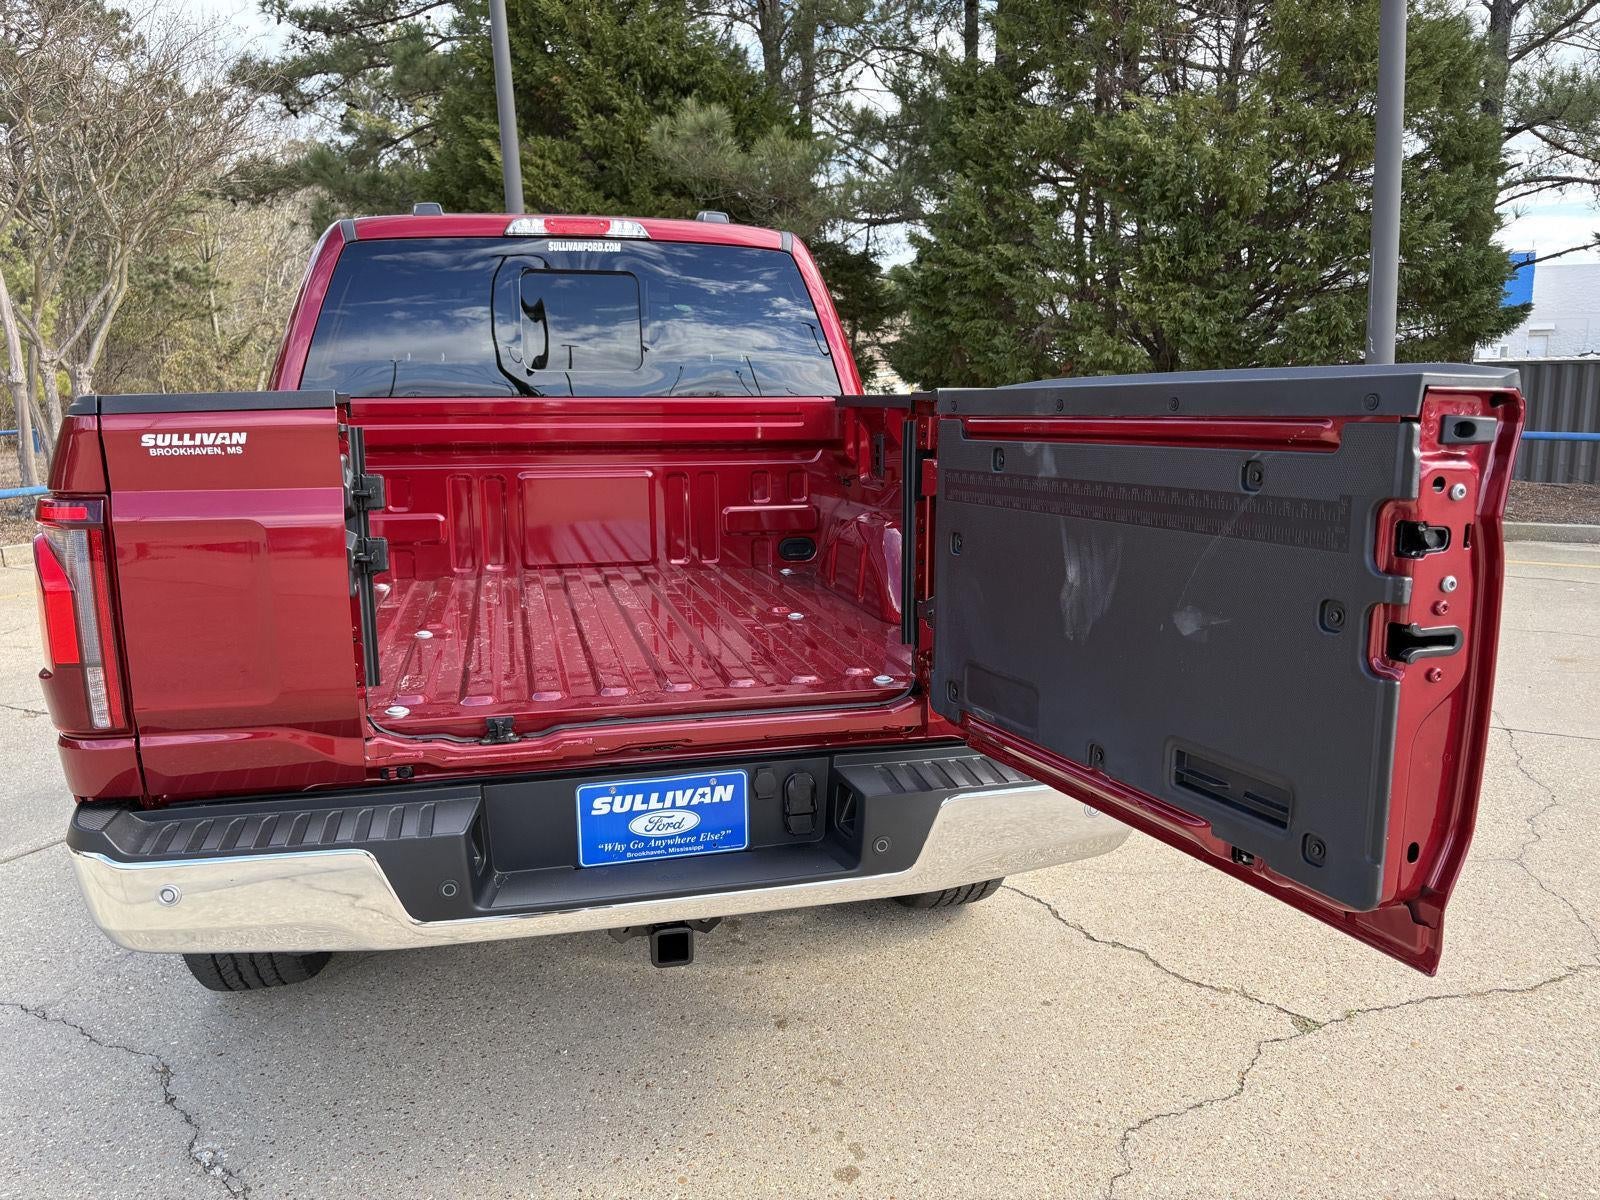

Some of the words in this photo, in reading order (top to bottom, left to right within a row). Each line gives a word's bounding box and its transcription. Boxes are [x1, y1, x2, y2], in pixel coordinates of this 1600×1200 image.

[548, 241, 621, 253] SULLIVANFORD.COM
[141, 432, 247, 446] SULLIVAN
[149, 447, 225, 456] BROOKHAVEN,
[226, 446, 243, 454] MS
[591, 784, 734, 815] SULLIVAN
[645, 815, 685, 832] Ford
[630, 839, 645, 849] Go
[648, 836, 696, 848] Anywhere
[627, 849, 667, 858] Brookhaven,
[669, 844, 704, 854] Mississippi
